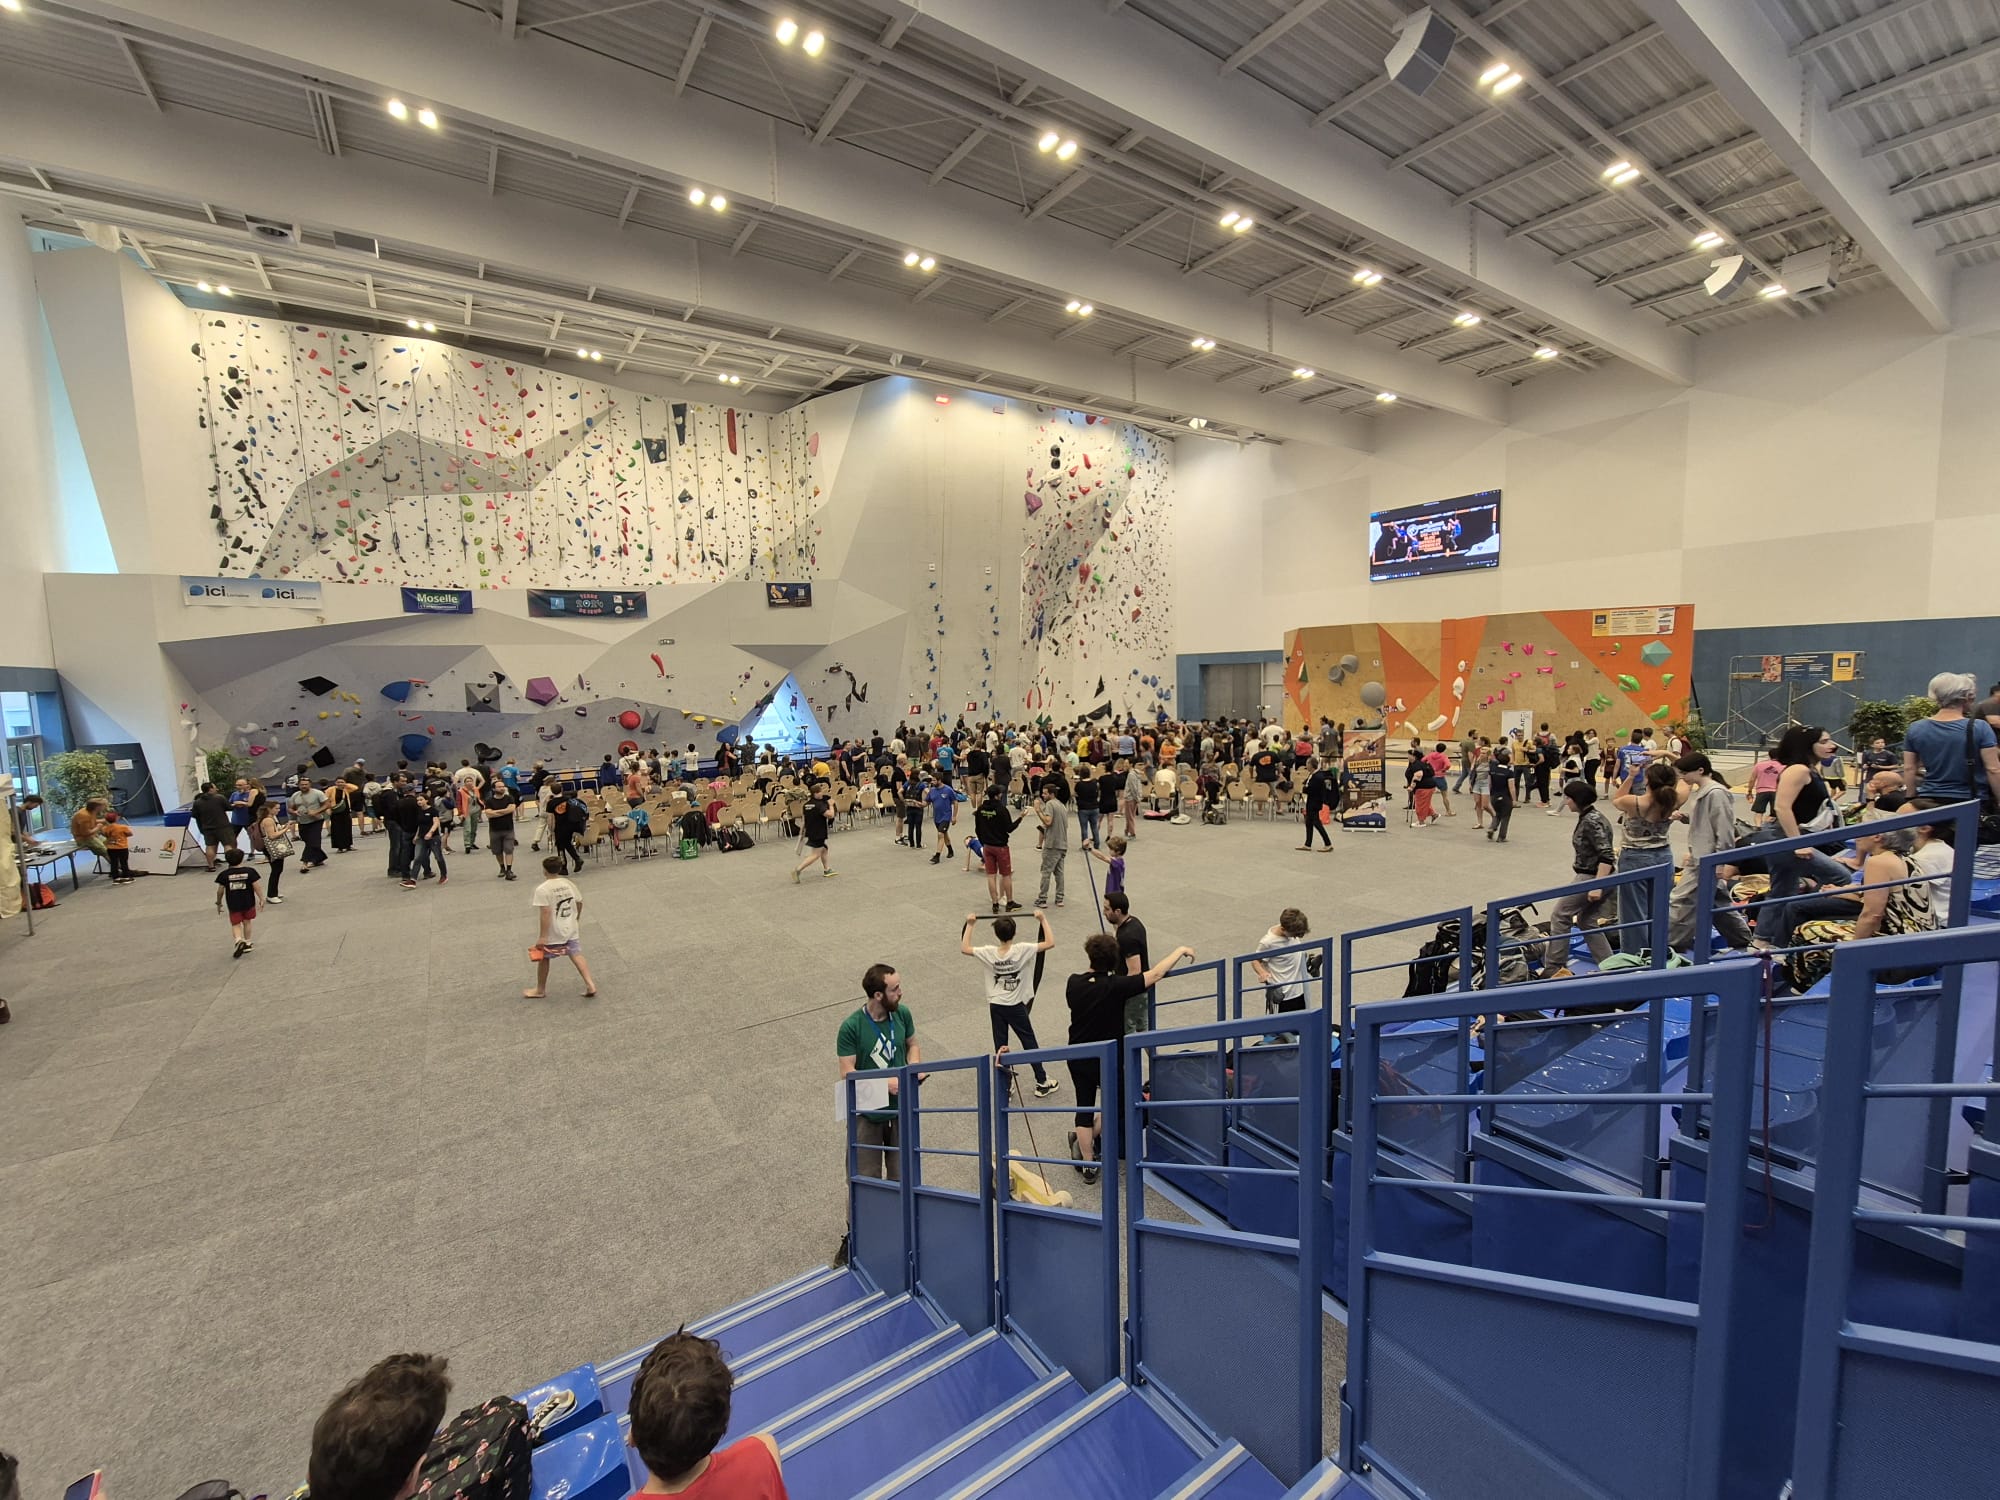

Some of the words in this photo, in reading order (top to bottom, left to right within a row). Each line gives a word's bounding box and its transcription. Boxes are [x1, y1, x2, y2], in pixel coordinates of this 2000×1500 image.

[205, 585, 226, 597] ici
[276, 588, 295, 600] ici
[416, 593, 458, 604] Moselle
